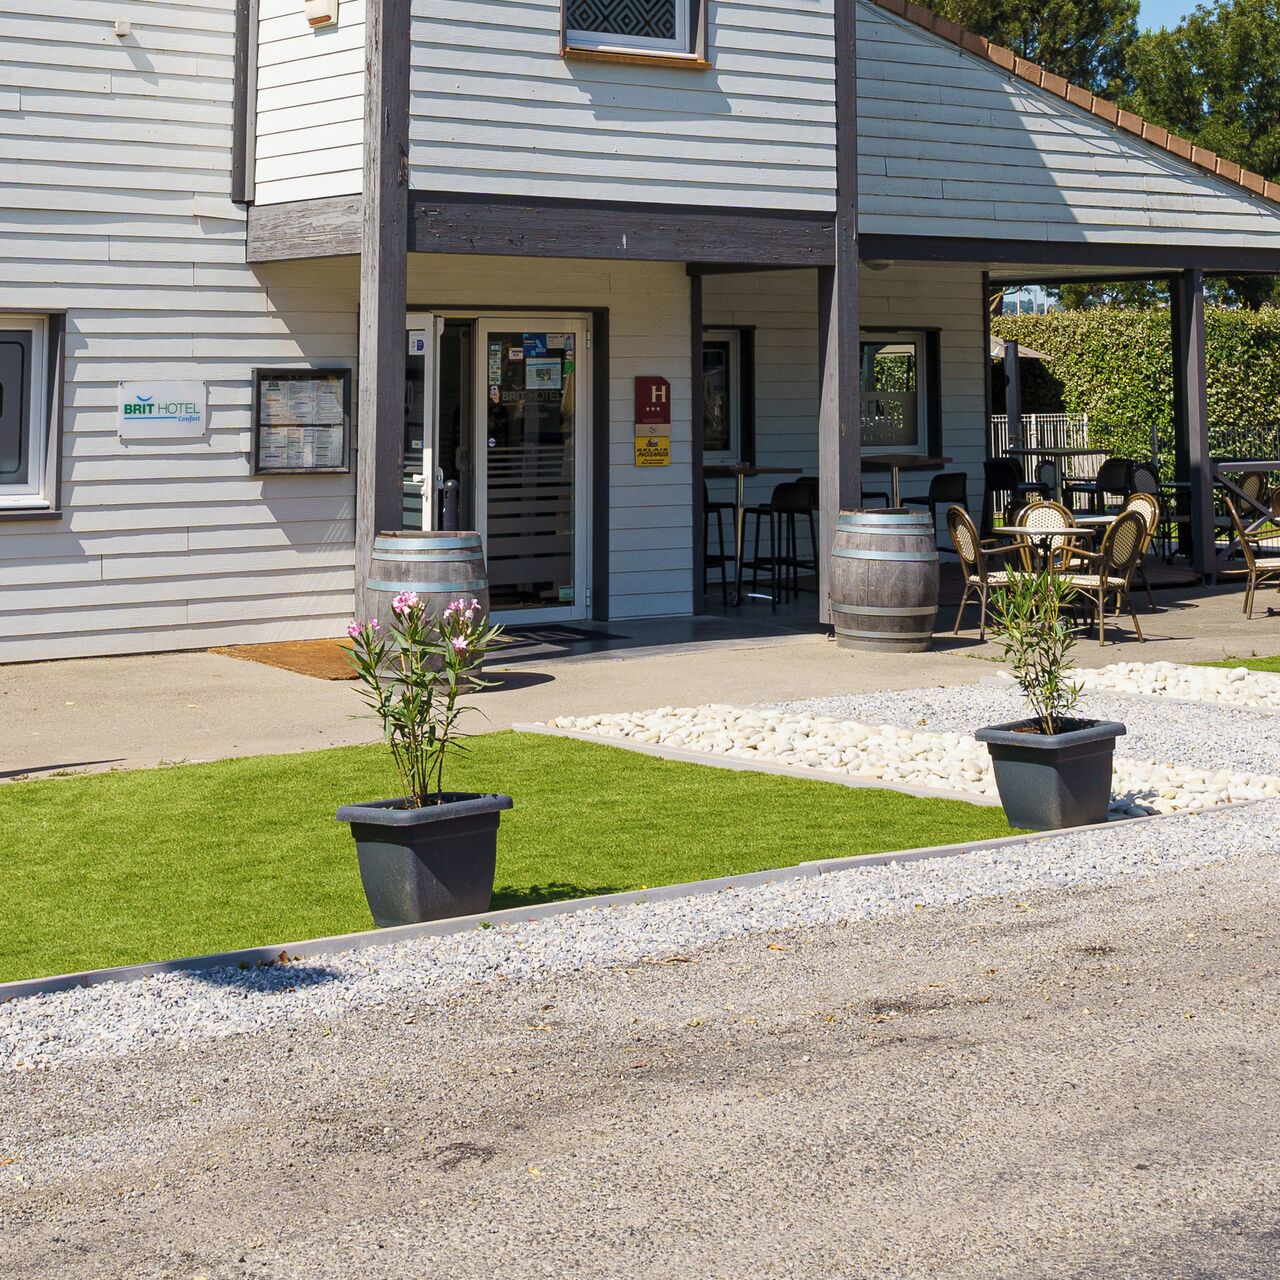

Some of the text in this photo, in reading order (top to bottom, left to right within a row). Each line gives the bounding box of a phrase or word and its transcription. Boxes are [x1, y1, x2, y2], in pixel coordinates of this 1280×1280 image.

[651, 385, 667, 403] H
[124, 402, 201, 415] BRIT HOTEL
